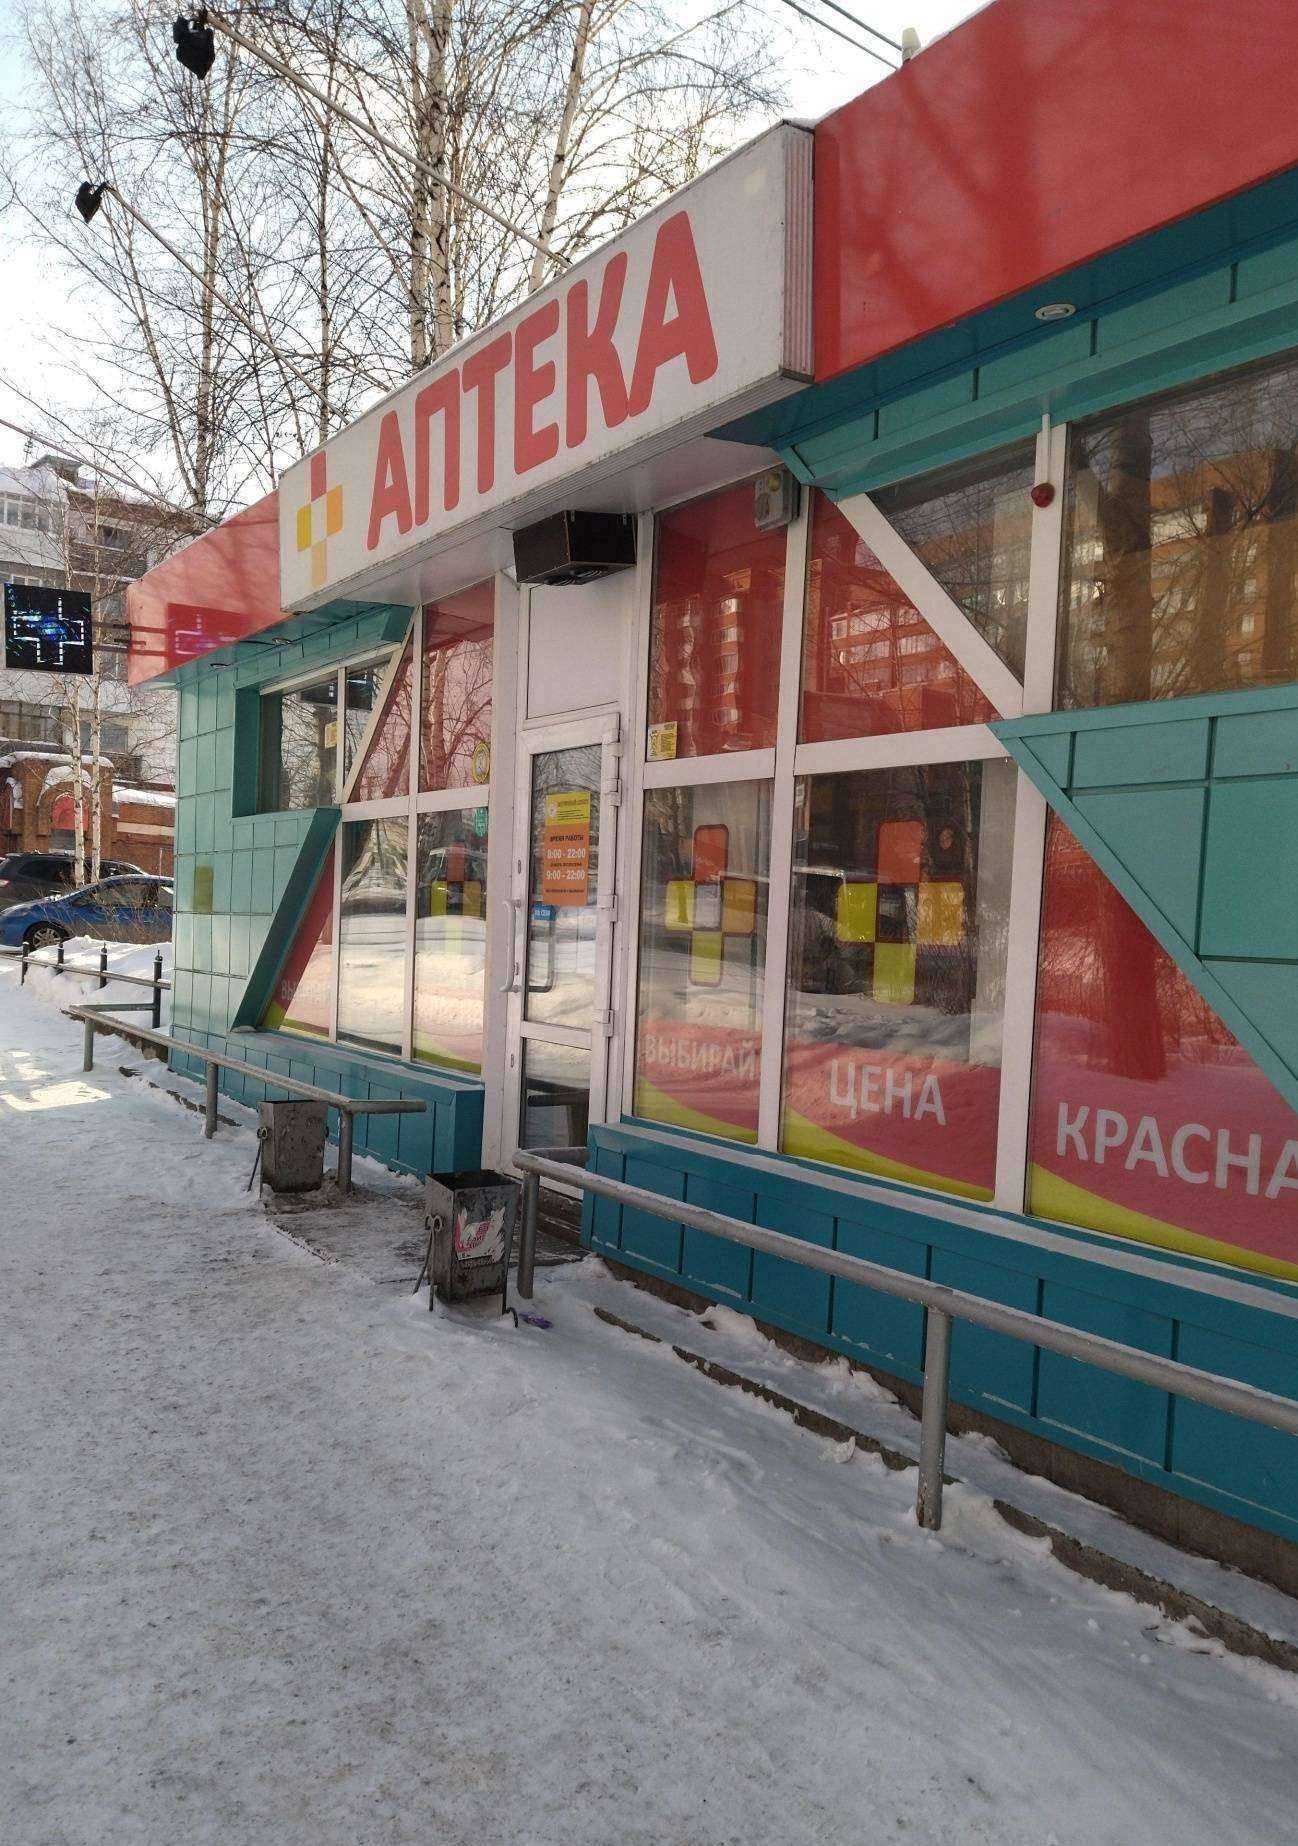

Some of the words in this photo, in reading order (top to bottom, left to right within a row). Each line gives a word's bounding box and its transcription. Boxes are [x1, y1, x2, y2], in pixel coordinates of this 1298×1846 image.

[366, 210, 719, 551] АПТЕКА
[546, 869, 561, 881] 9:00
[566, 869, 586, 881] 22:00
[567, 847, 586, 858] 22:00
[644, 1033, 756, 1081] ВЫБИРАЙ
[830, 1058, 947, 1126] ЦЕНА
[1056, 1101, 1298, 1200] КРАСНА
